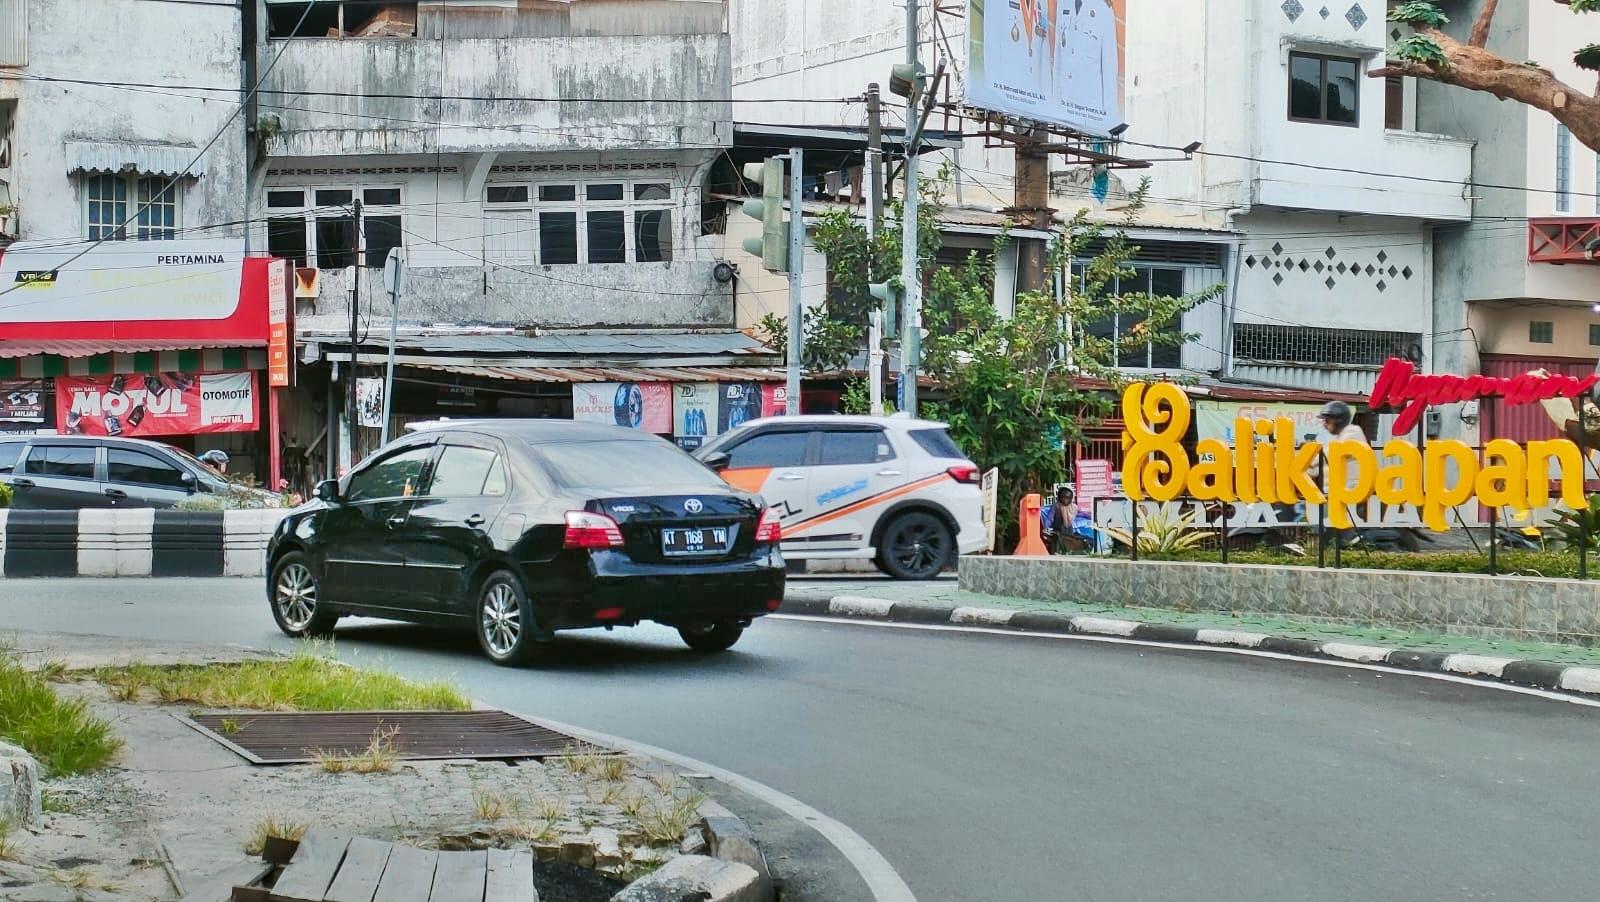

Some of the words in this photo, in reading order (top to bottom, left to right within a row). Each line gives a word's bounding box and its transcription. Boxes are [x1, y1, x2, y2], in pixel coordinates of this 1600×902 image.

[157, 255, 225, 264] PERTAMINA
[203, 389, 249, 402] OTOMOTIF
[71, 389, 188, 416] MOTUL
[212, 415, 243, 425] MOTUL
[1122, 382, 1588, 531] Balikpapan
[664, 531, 675, 544] KT
[685, 530, 704, 544] 1168
